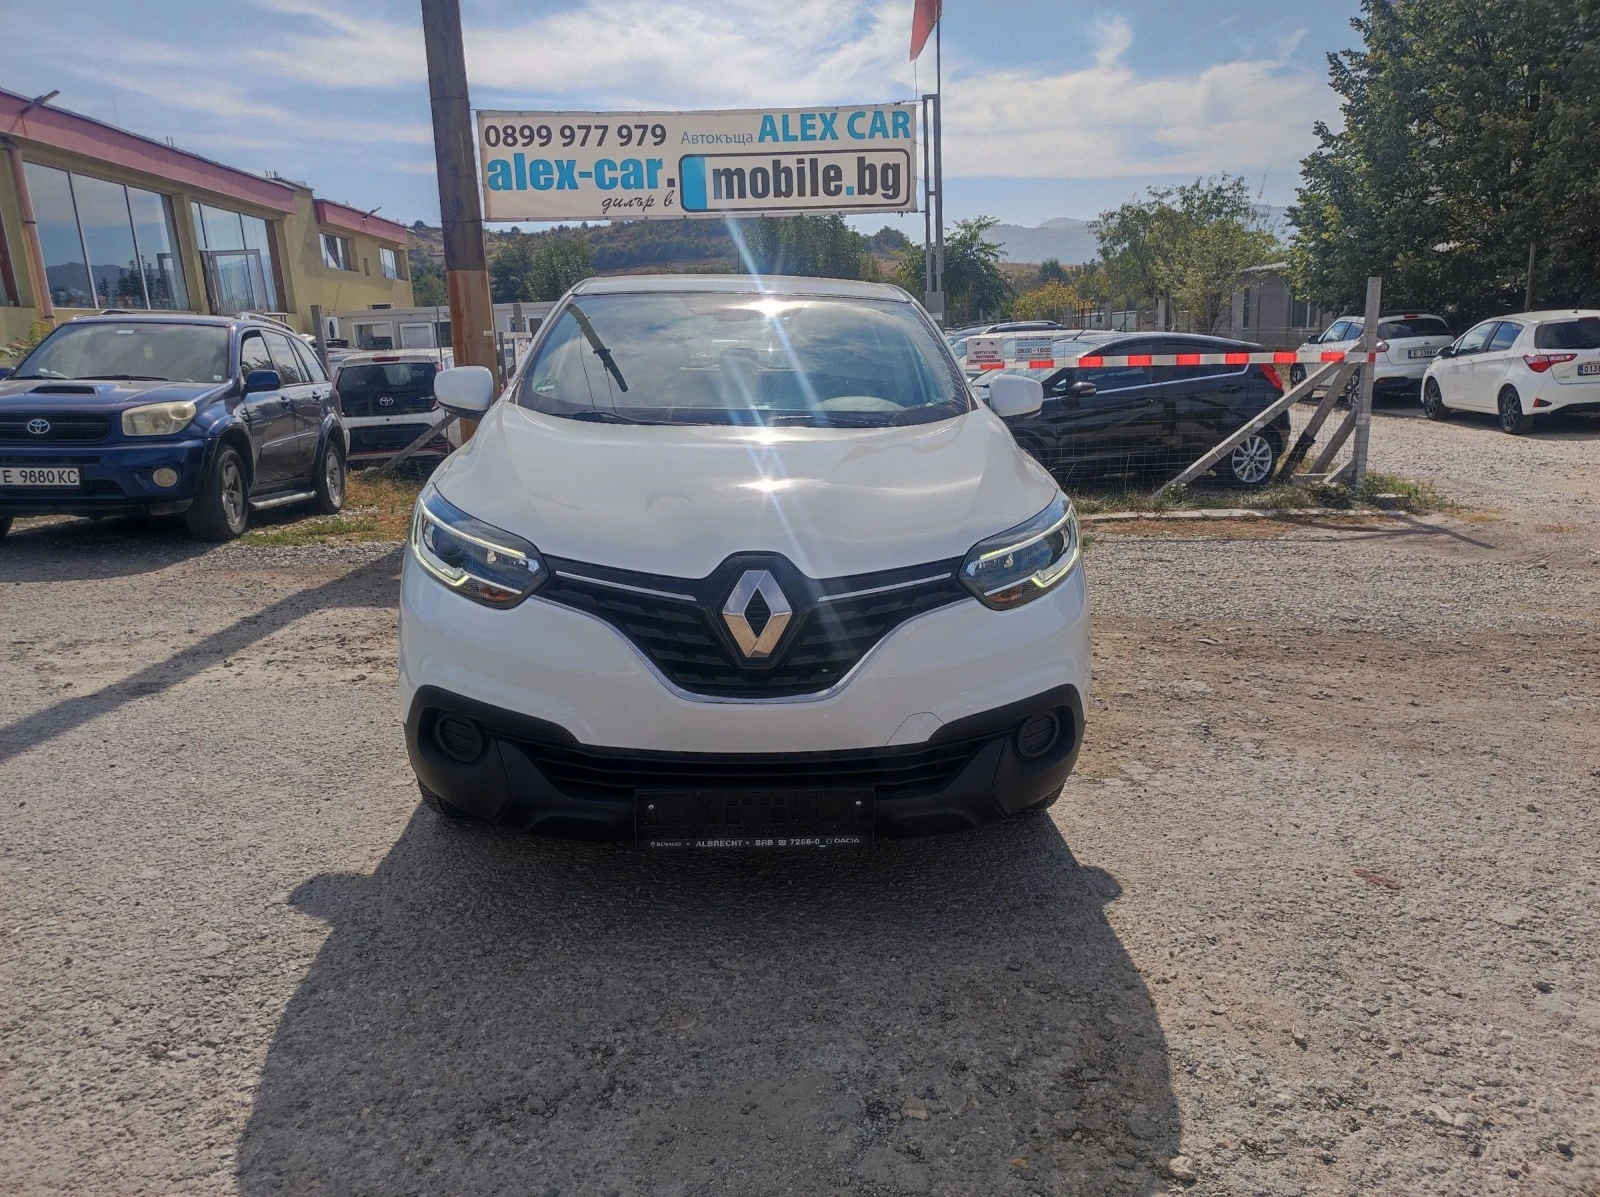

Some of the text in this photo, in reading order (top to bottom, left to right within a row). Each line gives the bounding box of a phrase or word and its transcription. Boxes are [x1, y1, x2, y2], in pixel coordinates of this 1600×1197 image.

[485, 123, 667, 147] 0899 977 979
[680, 131, 753, 145] Автокъща
[757, 111, 911, 143] ALEX CAR
[712, 156, 901, 200] mobile.bg
[601, 190, 675, 214] дилър в
[2, 470, 78, 484] E 9880 KC
[696, 840, 743, 848] ALBRECHT
